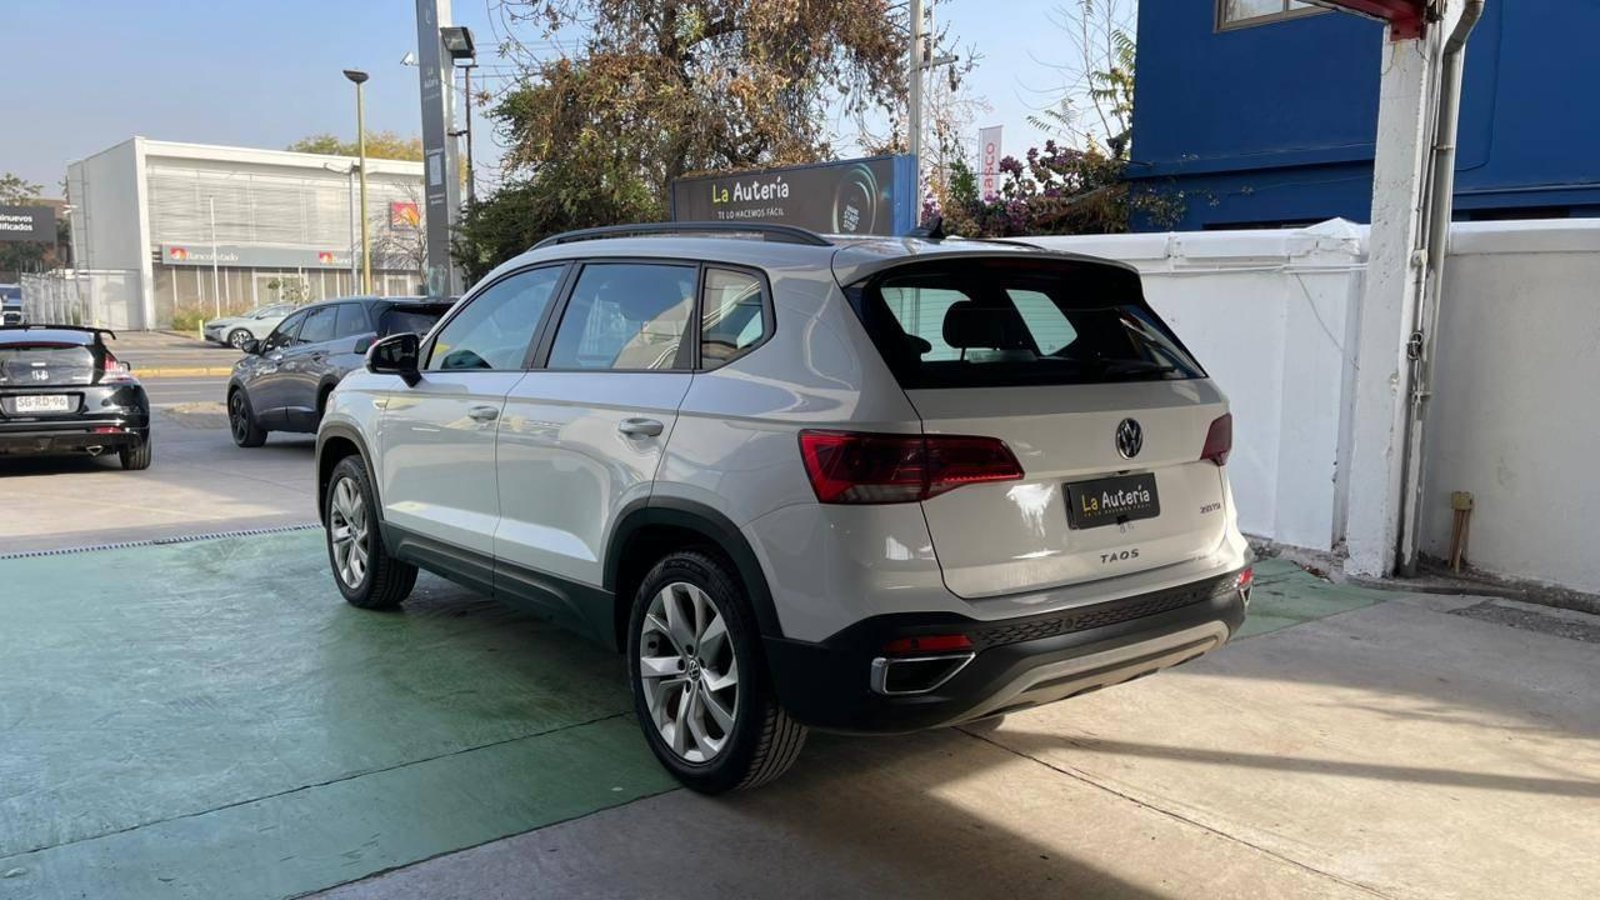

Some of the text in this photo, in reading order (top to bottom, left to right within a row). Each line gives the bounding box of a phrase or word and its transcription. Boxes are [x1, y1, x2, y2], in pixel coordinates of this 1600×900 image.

[713, 176, 790, 203] La Autería
[0, 213, 33, 222] inuevos
[0, 223, 33, 231] ificados
[1082, 494, 1098, 512] La
[1102, 484, 1150, 509] Autería
[1100, 548, 1139, 564] TAOS
